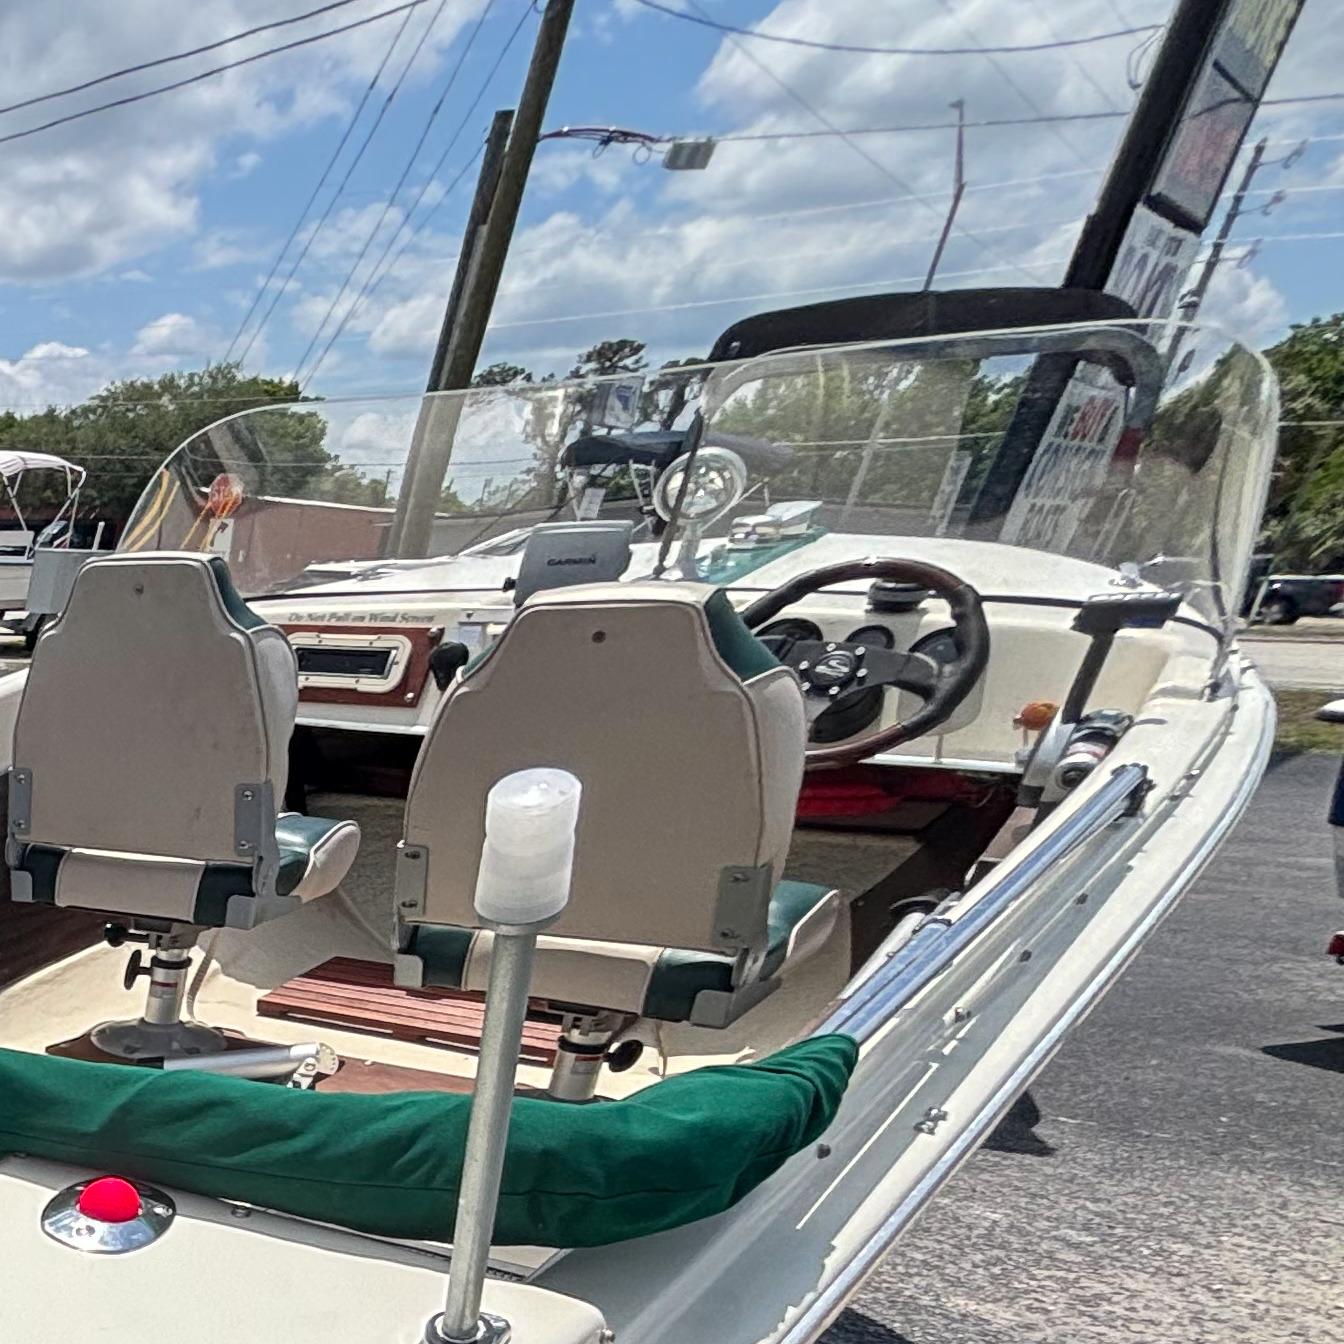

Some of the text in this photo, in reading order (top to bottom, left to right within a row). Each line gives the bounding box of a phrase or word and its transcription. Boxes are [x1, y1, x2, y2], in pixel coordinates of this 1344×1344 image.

[547, 556, 596, 566] GARMIN
[288, 612, 304, 622] Do
[307, 612, 326, 622] Not
[368, 612, 399, 622] Wind
